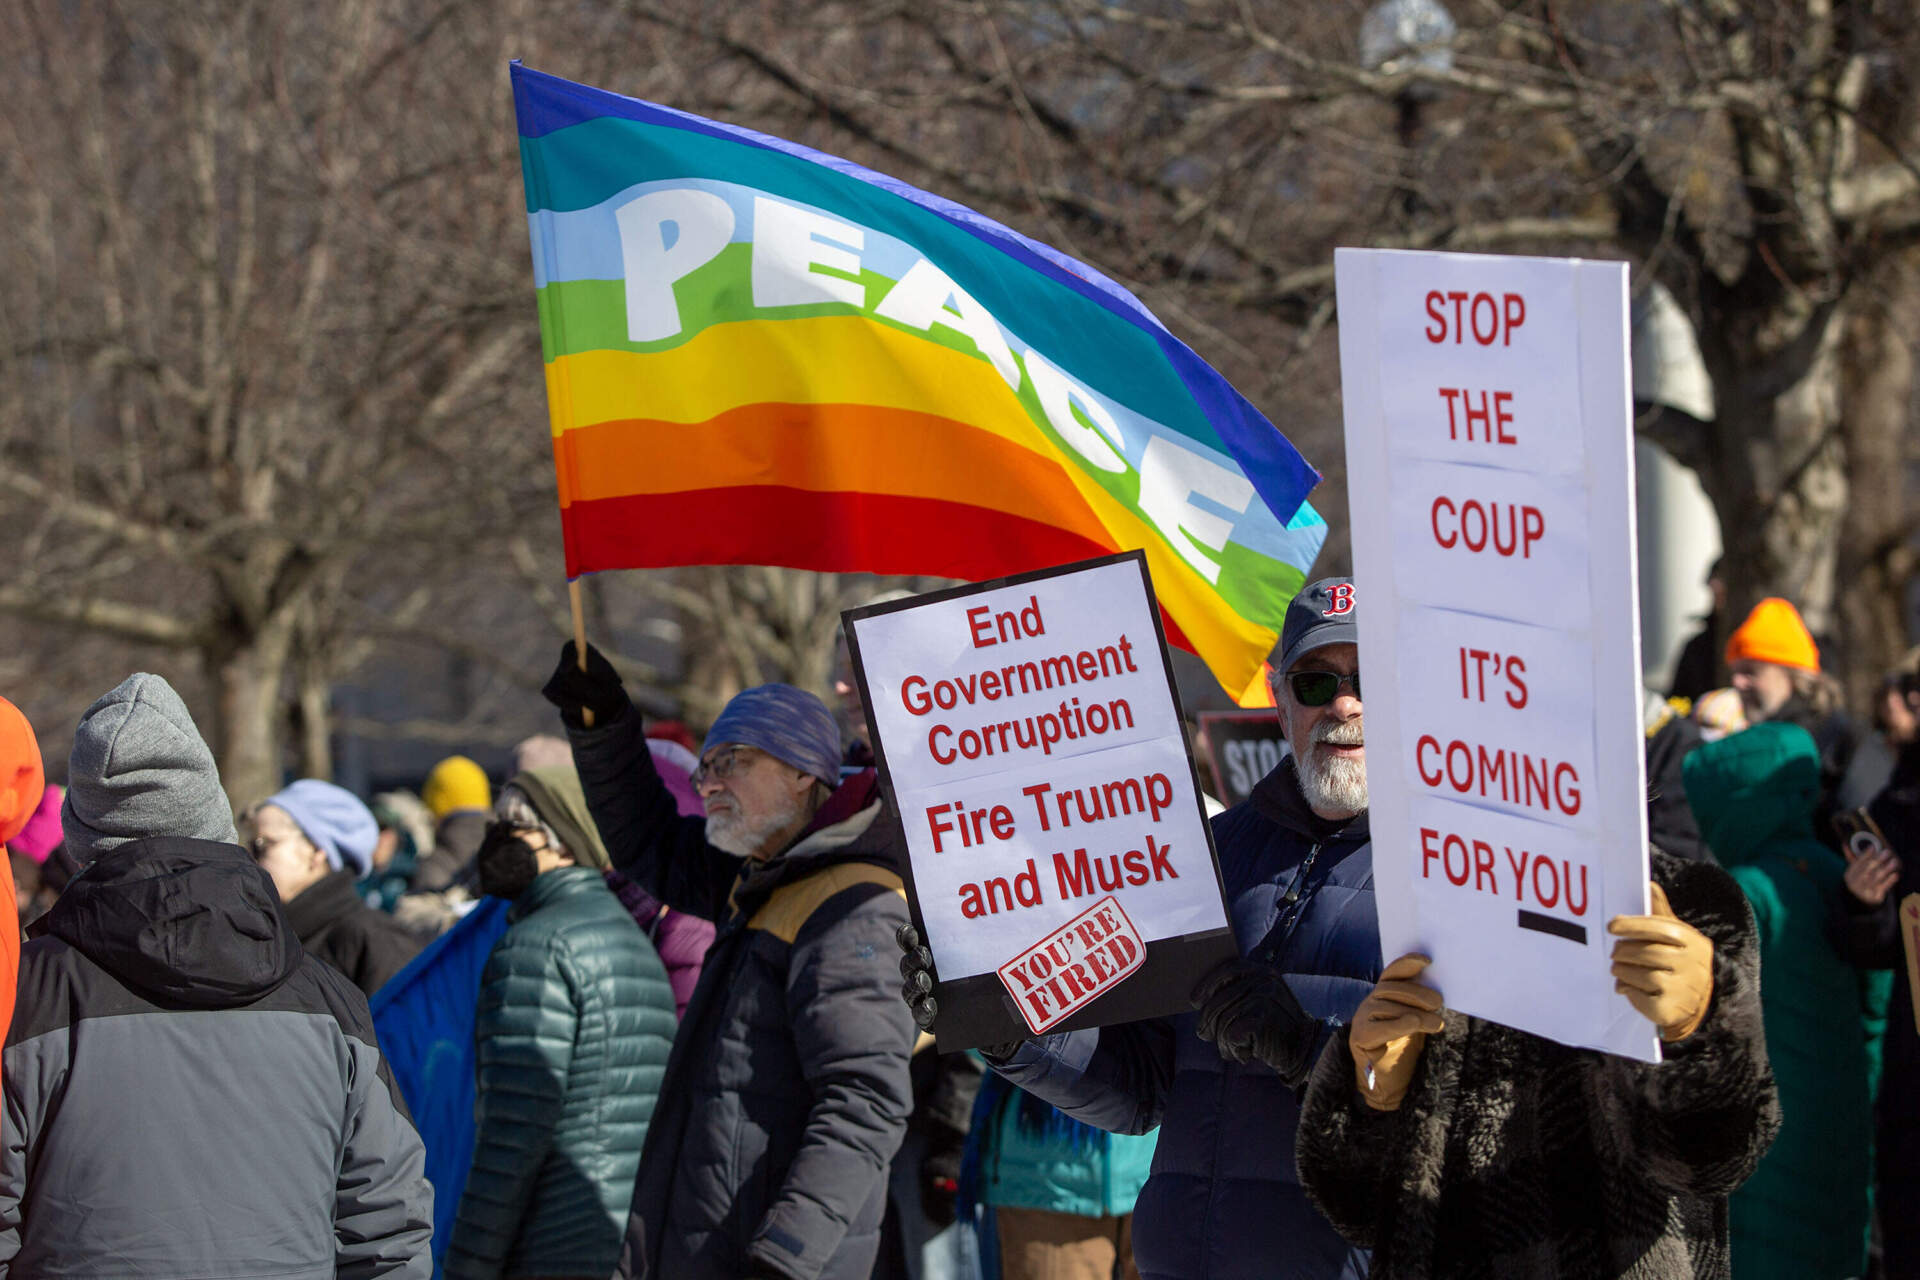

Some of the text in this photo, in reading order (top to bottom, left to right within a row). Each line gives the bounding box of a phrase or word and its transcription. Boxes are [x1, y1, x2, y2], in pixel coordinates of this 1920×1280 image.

[1425, 290, 1526, 347] STOP
[616, 188, 1255, 586] PEACE
[1439, 387, 1517, 446] THE
[1431, 495, 1545, 560] COUP
[966, 595, 1045, 649] End
[1322, 583, 1356, 617] B
[901, 634, 1137, 716] Government
[1460, 647, 1529, 710] IT'S
[928, 697, 1134, 765] Corruption
[1223, 739, 1291, 796] STO
[1415, 734, 1582, 817] COMING
[925, 773, 1173, 854] Fire Trump
[958, 835, 1178, 920] and Musk
[1420, 827, 1589, 918] FOR YOU
[1025, 934, 1138, 1024] FIRED
